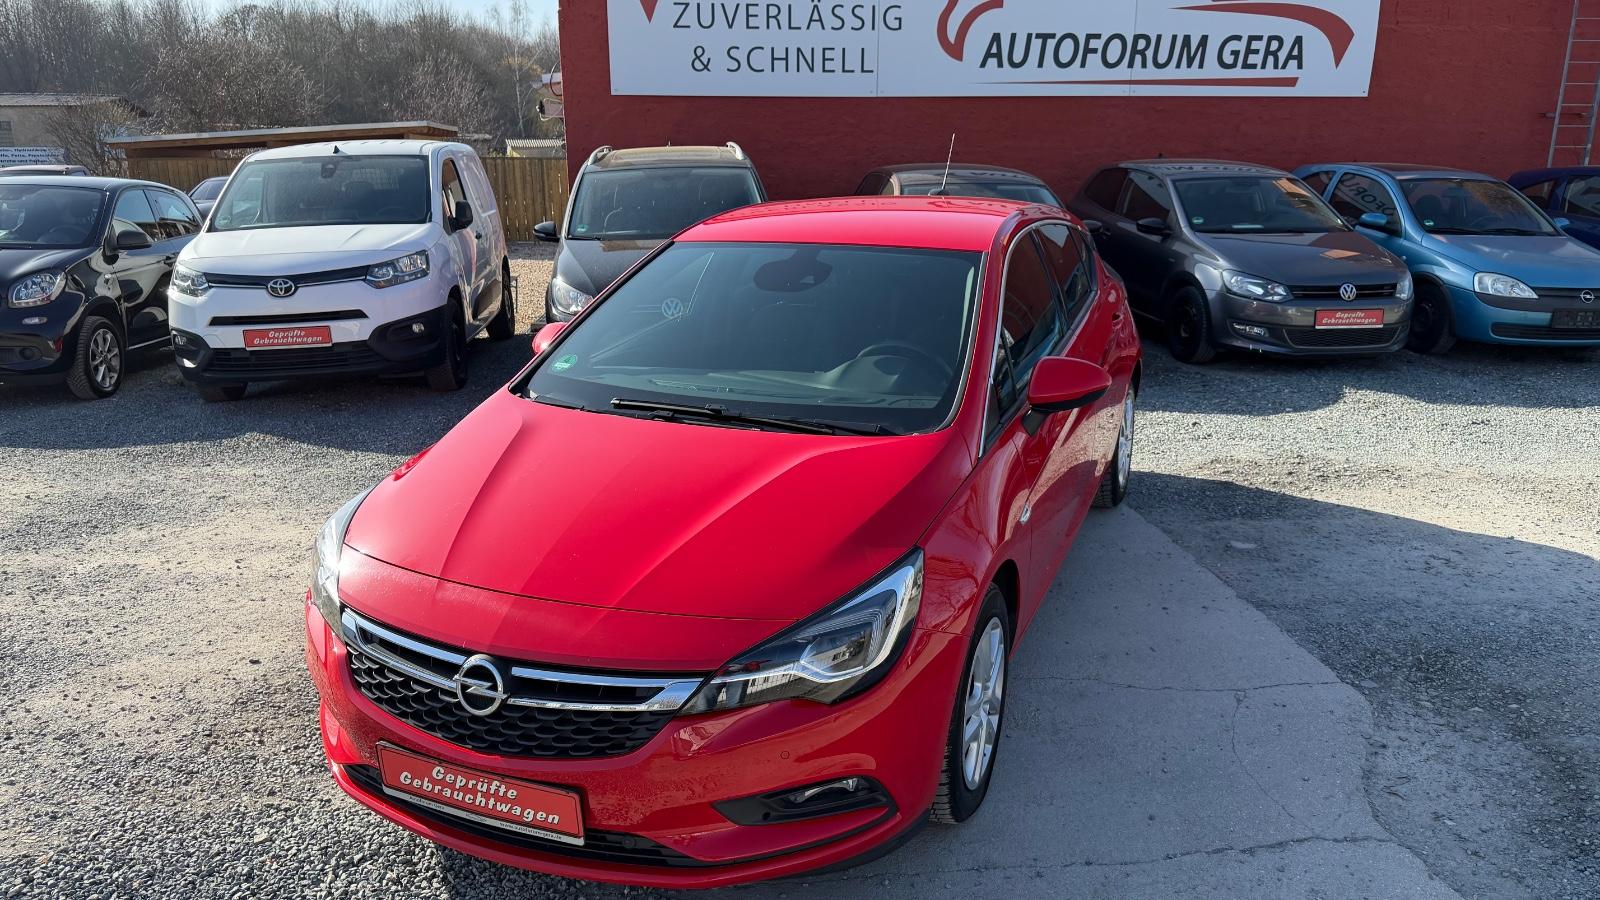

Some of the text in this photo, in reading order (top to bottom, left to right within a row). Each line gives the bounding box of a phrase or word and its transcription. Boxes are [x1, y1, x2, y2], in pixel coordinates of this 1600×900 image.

[672, 0, 903, 31] ZUVERLÄSSIG
[690, 45, 874, 73] & SCHNELL
[979, 32, 1304, 70] AUTOFORUM GERA
[253, 335, 323, 344] Gebrauchtwagen
[269, 329, 306, 338] Geprüfte
[399, 771, 560, 825] Gebrauchtwagen
[431, 766, 518, 800] Geprüfte
